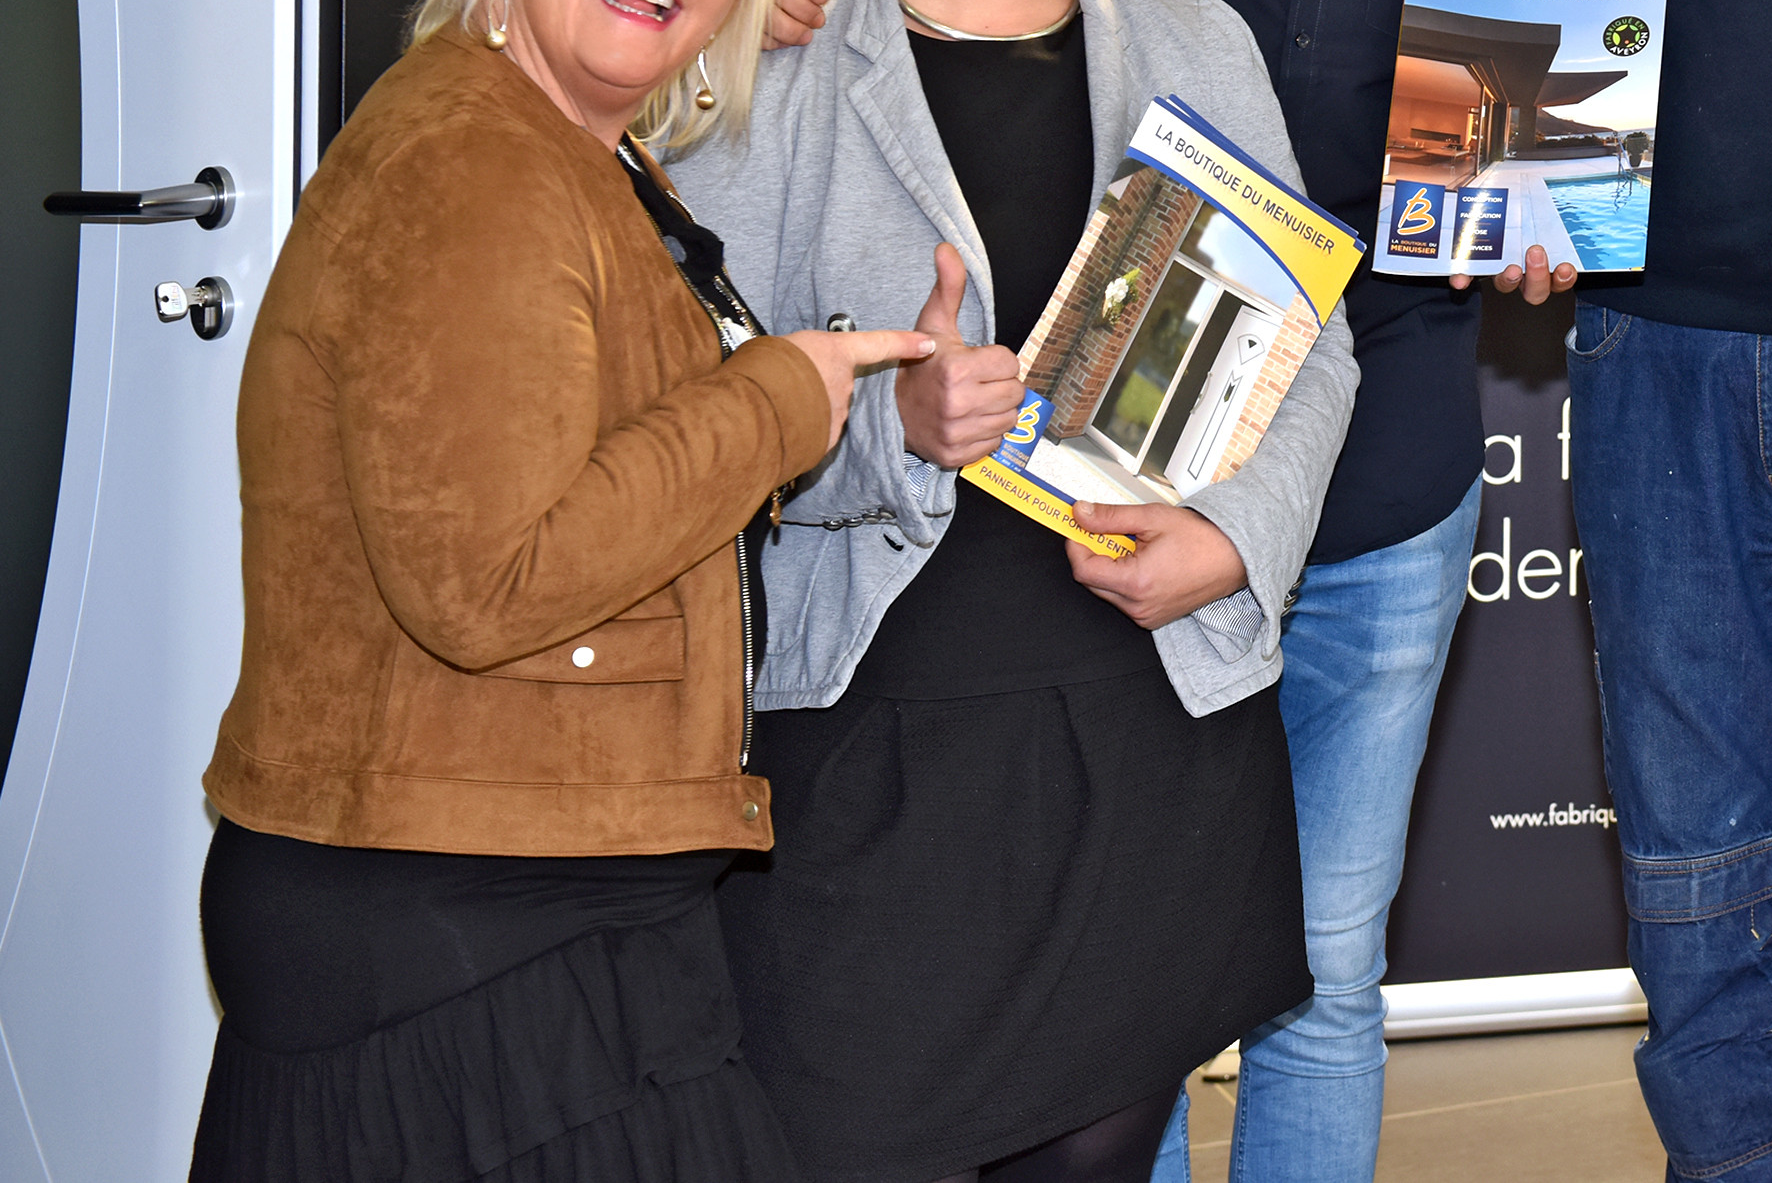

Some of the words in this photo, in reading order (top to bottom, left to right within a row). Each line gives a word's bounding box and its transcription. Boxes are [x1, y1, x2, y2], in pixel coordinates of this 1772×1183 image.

[1609, 31, 1649, 56] AVEYRON
[1155, 124, 1173, 146] LA
[1174, 137, 1242, 192] BOUTIQUE
[1241, 184, 1264, 206] DU
[1262, 199, 1335, 255] MENUISIER
[1461, 196, 1503, 204] CONPTION
[1460, 212, 1502, 220] FACATION
[1390, 244, 1437, 255] MENUISIER
[979, 465, 1031, 503] PANNEAUX
[1031, 497, 1061, 520] POUR
[1489, 802, 1618, 829] www.fabriqu
